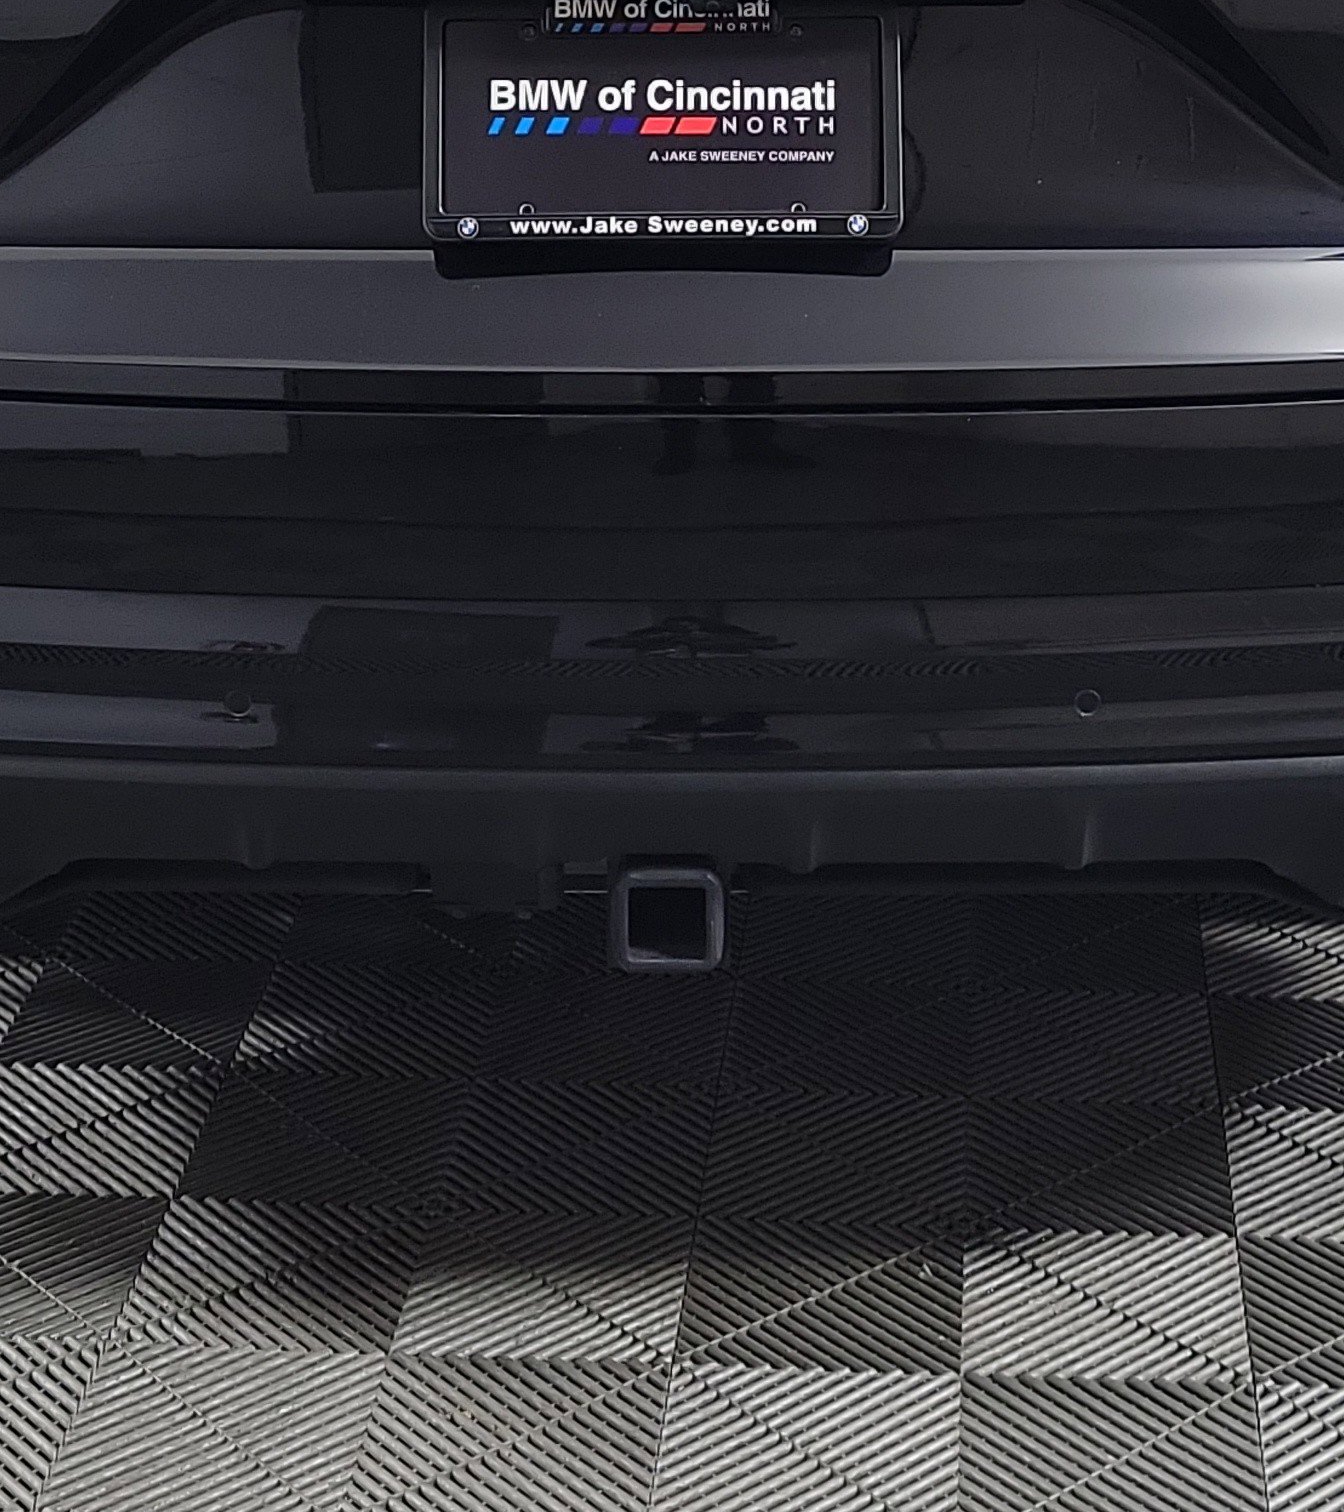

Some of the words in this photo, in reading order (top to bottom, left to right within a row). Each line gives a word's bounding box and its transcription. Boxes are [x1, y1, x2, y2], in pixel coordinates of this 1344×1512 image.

[714, 23, 771, 31] NORTH
[489, 80, 586, 111] BMW
[597, 80, 635, 111] of
[646, 79, 836, 111] Cincinnati
[722, 117, 835, 135] NORTH
[649, 151, 659, 161] A
[661, 151, 697, 162] JAKE
[700, 151, 765, 162] SWEENEY
[768, 151, 835, 162] COMPANY
[510, 216, 638, 235] www.Jake
[647, 215, 817, 235] Sweeney.com
